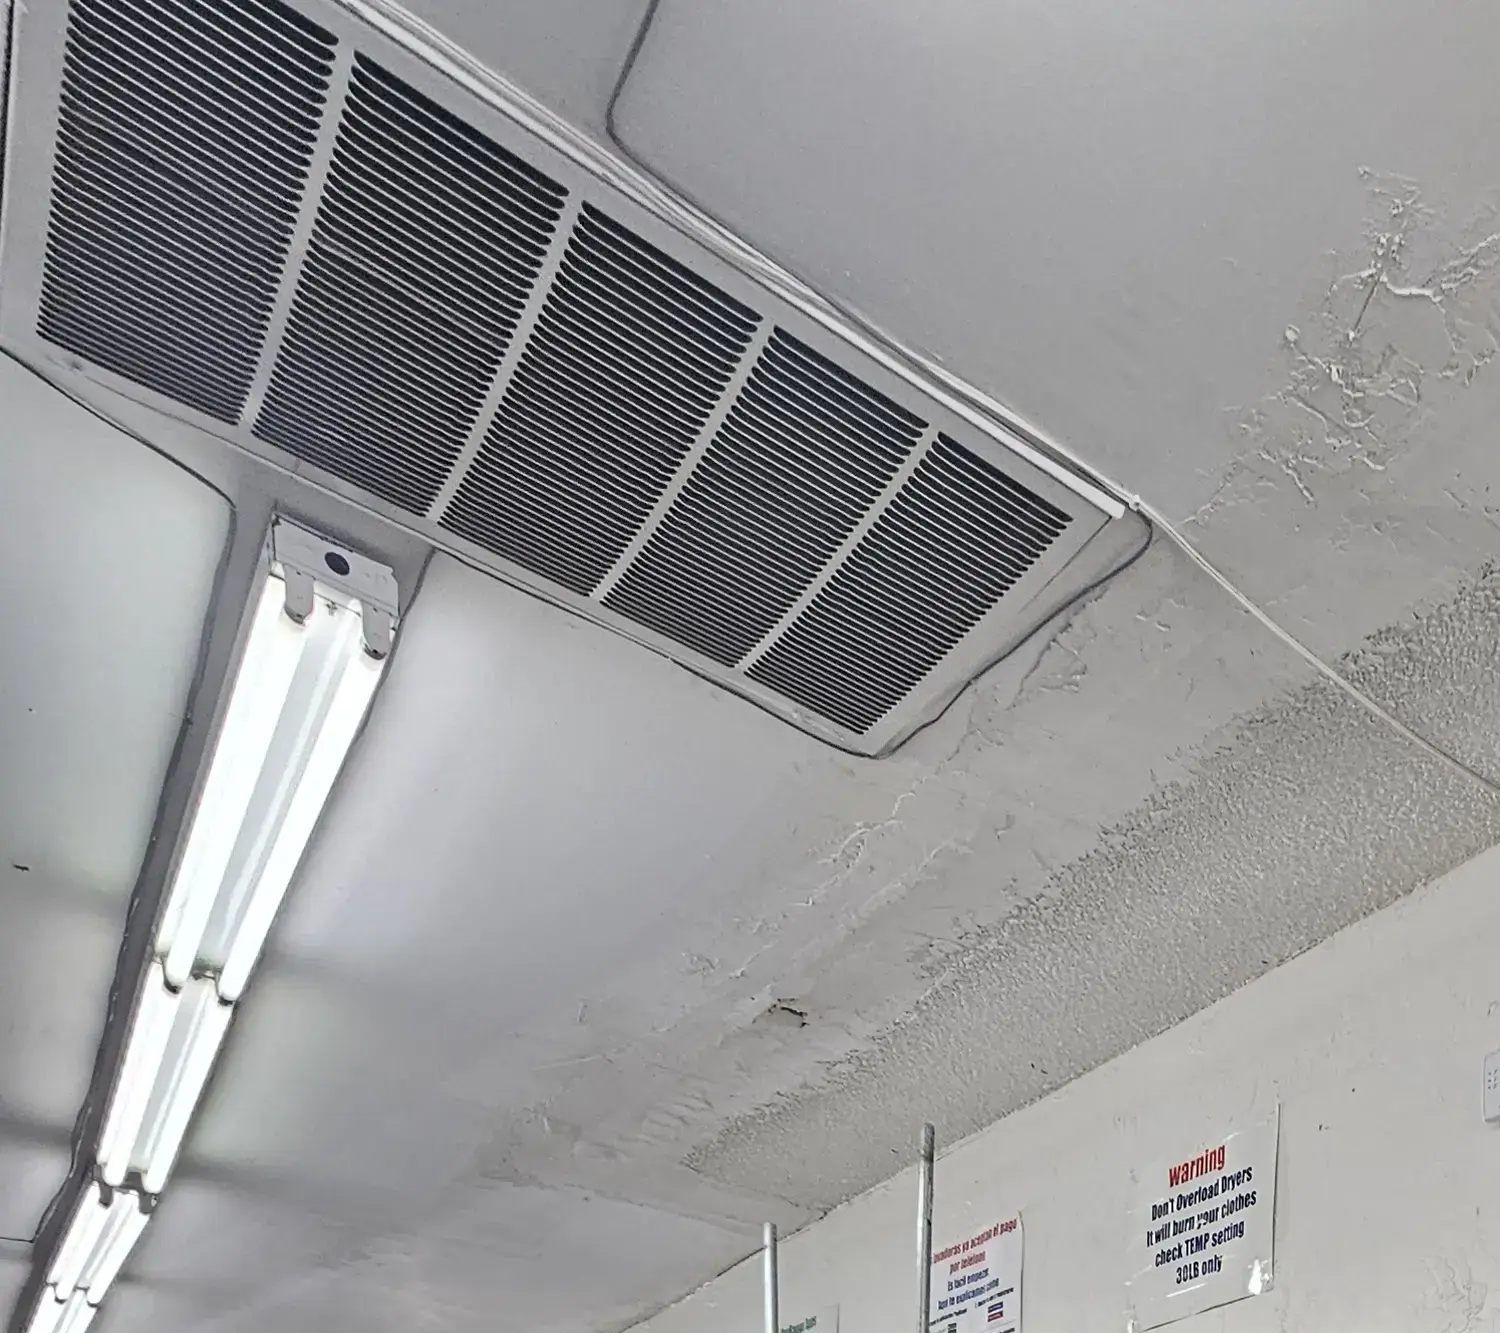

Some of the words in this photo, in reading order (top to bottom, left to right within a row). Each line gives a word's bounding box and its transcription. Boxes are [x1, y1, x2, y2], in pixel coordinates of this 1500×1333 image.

[1146, 1231, 1154, 1247] It
[1155, 1222, 1170, 1244] will
[1172, 1216, 1194, 1237] burn
[1197, 1208, 1219, 1230] your
[1221, 1190, 1256, 1219] clothes
[1151, 1197, 1174, 1222] Don't
[1176, 1178, 1219, 1211] Overload
[1221, 1166, 1252, 1194] Dryers
[1155, 1242, 1183, 1267] check
[1185, 1233, 1209, 1257] TEMP
[1211, 1221, 1244, 1247] setting
[1176, 1260, 1199, 1285] 30LB
[1201, 1254, 1222, 1276] only
